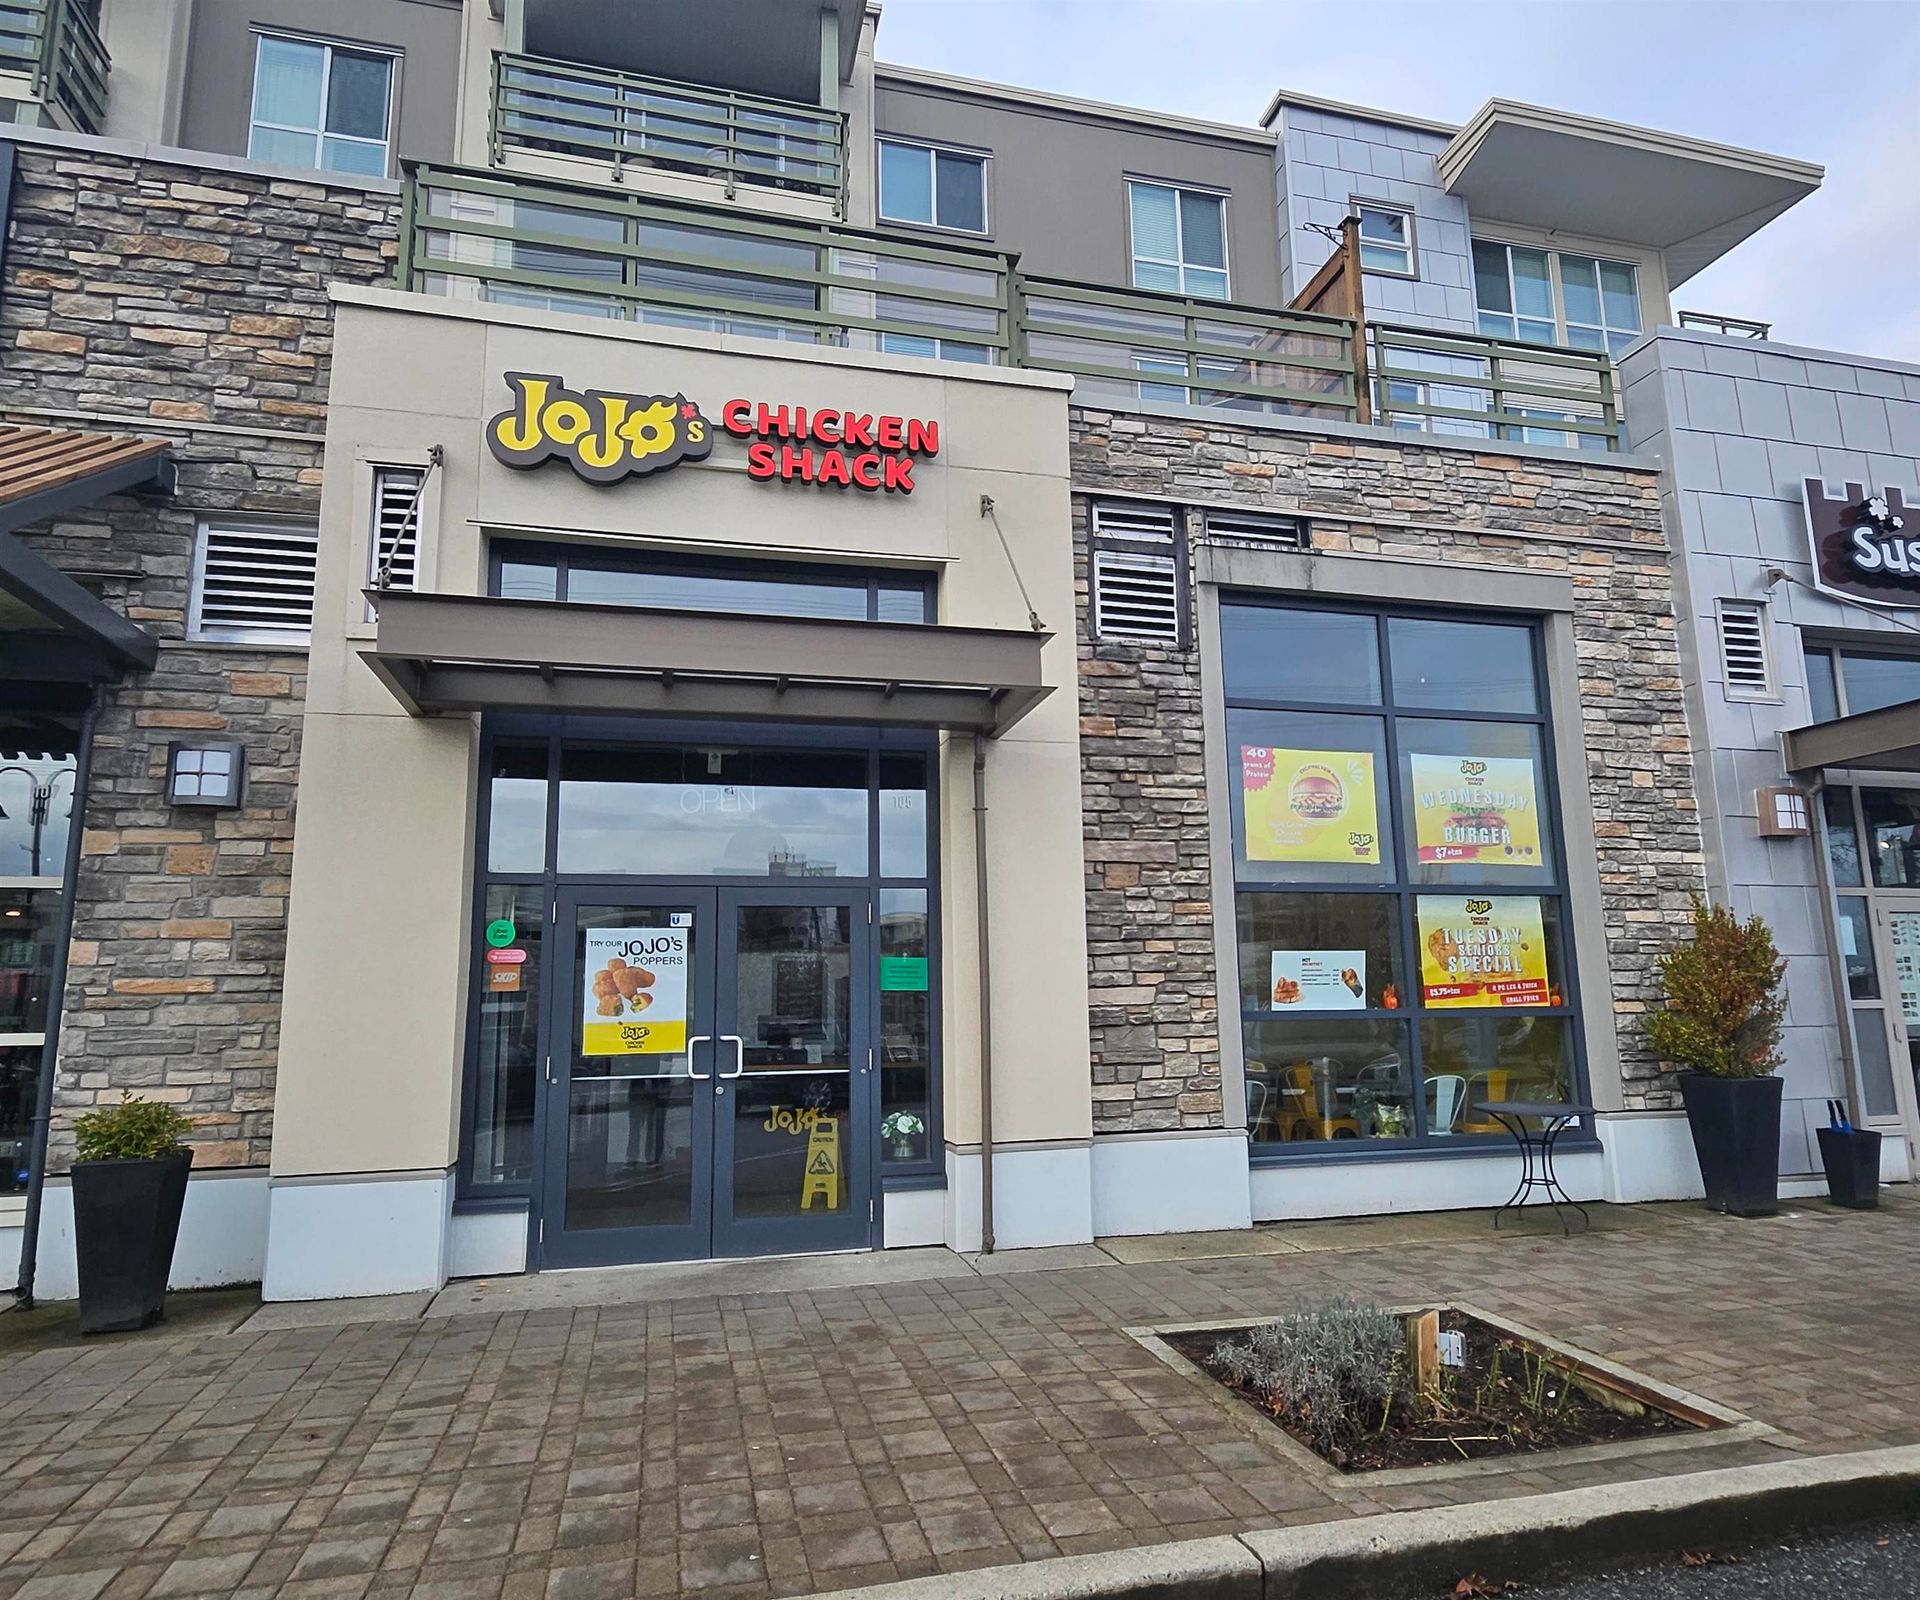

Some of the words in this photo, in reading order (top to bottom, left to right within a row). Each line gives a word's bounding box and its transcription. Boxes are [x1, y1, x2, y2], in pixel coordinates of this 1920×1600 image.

[723, 398, 939, 459] CHICKEN
[747, 442, 915, 495] SHACK
[1246, 748, 1267, 758] 40
[680, 786, 756, 816] OPEN
[1420, 787, 1529, 812] WEDNESDAY
[1443, 826, 1511, 844] BURGER
[590, 940, 604, 948] TRY
[1442, 928, 1521, 944] TUESDAY
[1458, 945, 1510, 956] SENIORS
[633, 956, 683, 965] POPPERS
[1448, 956, 1522, 973] SPECIAL
[493, 972, 517, 983] SKIP
